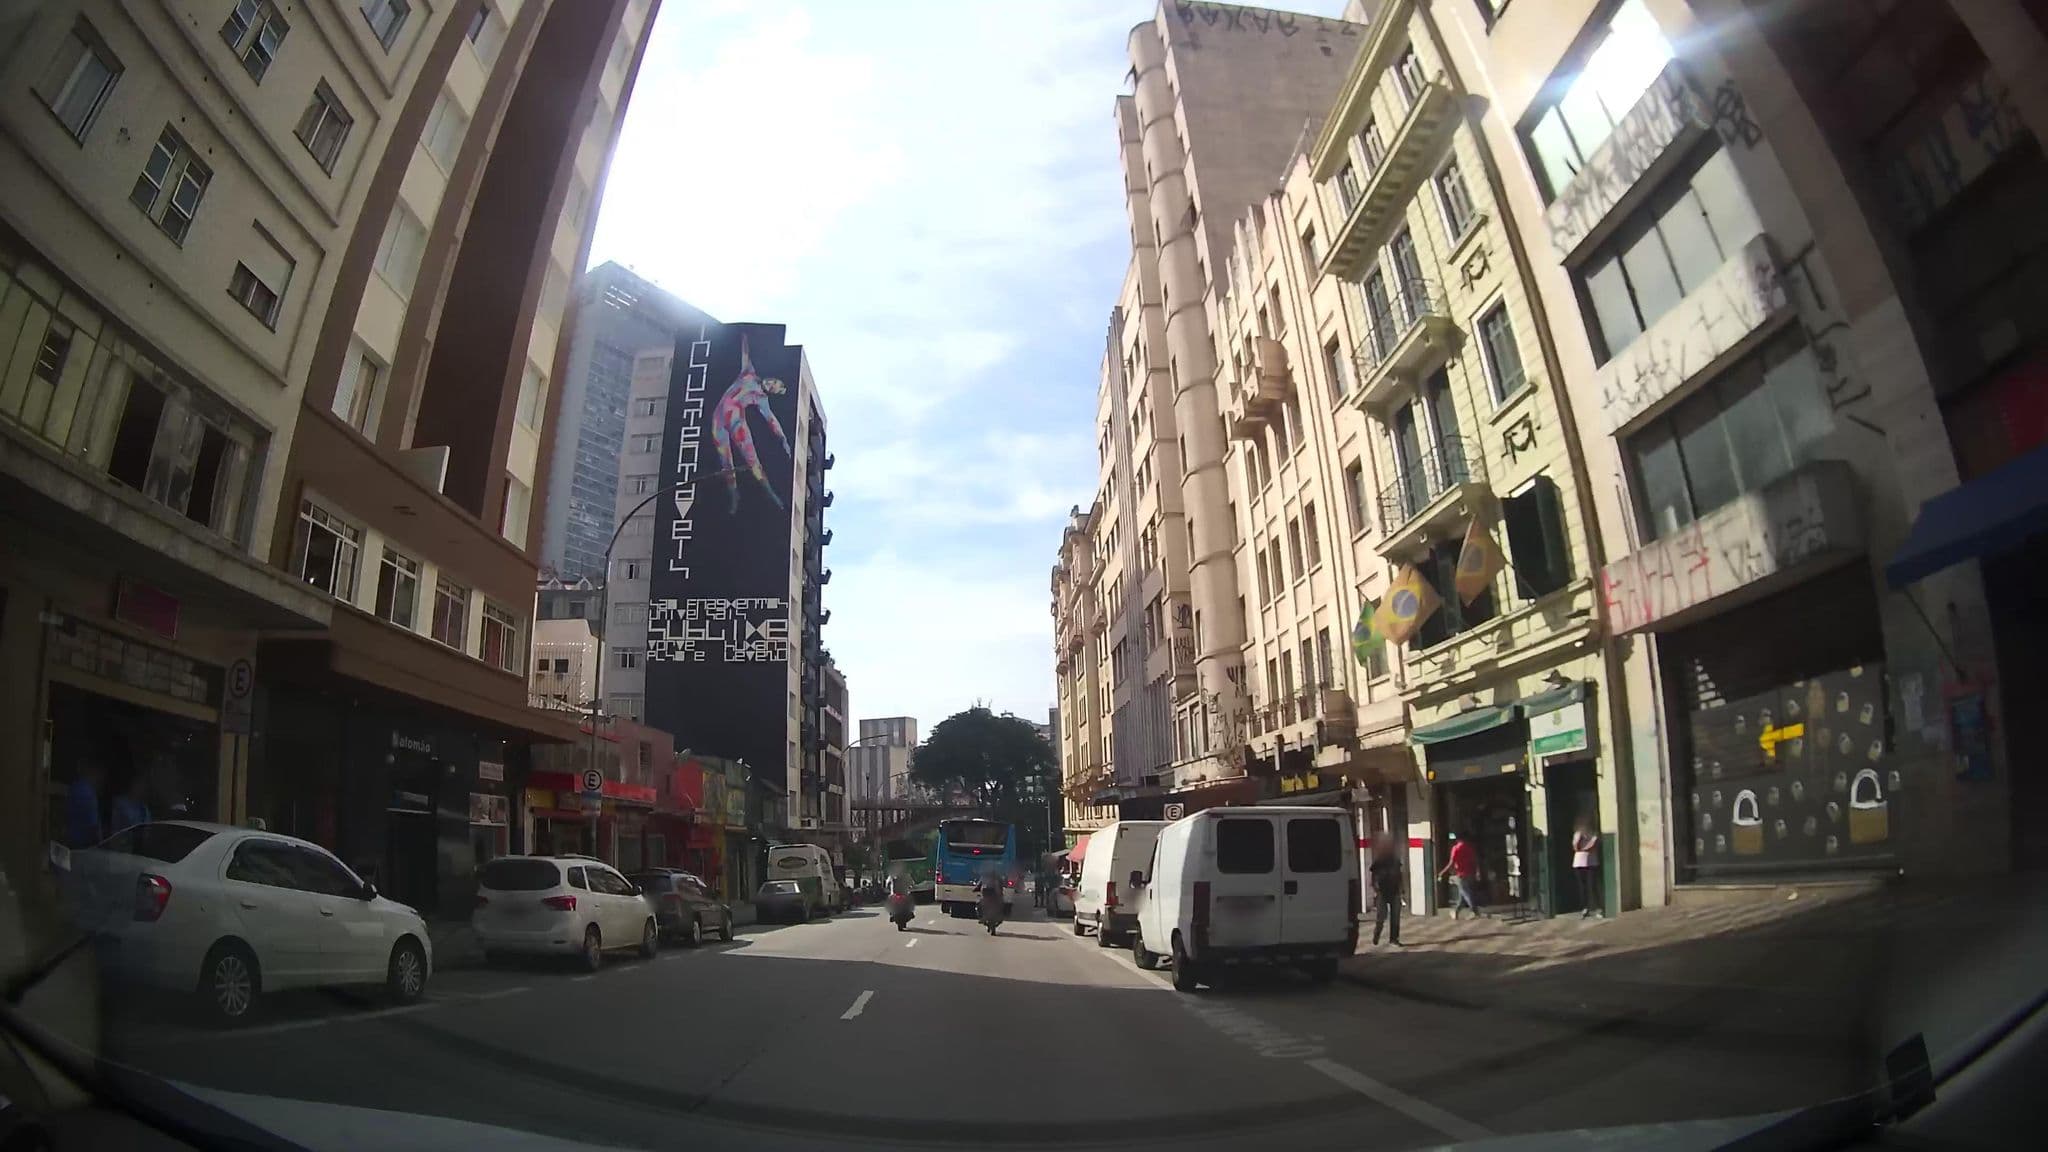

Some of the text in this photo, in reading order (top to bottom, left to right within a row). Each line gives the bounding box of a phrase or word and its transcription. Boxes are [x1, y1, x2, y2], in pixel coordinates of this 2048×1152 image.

[235, 667, 247, 691] E
[587, 774, 597, 787] E
[1170, 807, 1178, 818] E
